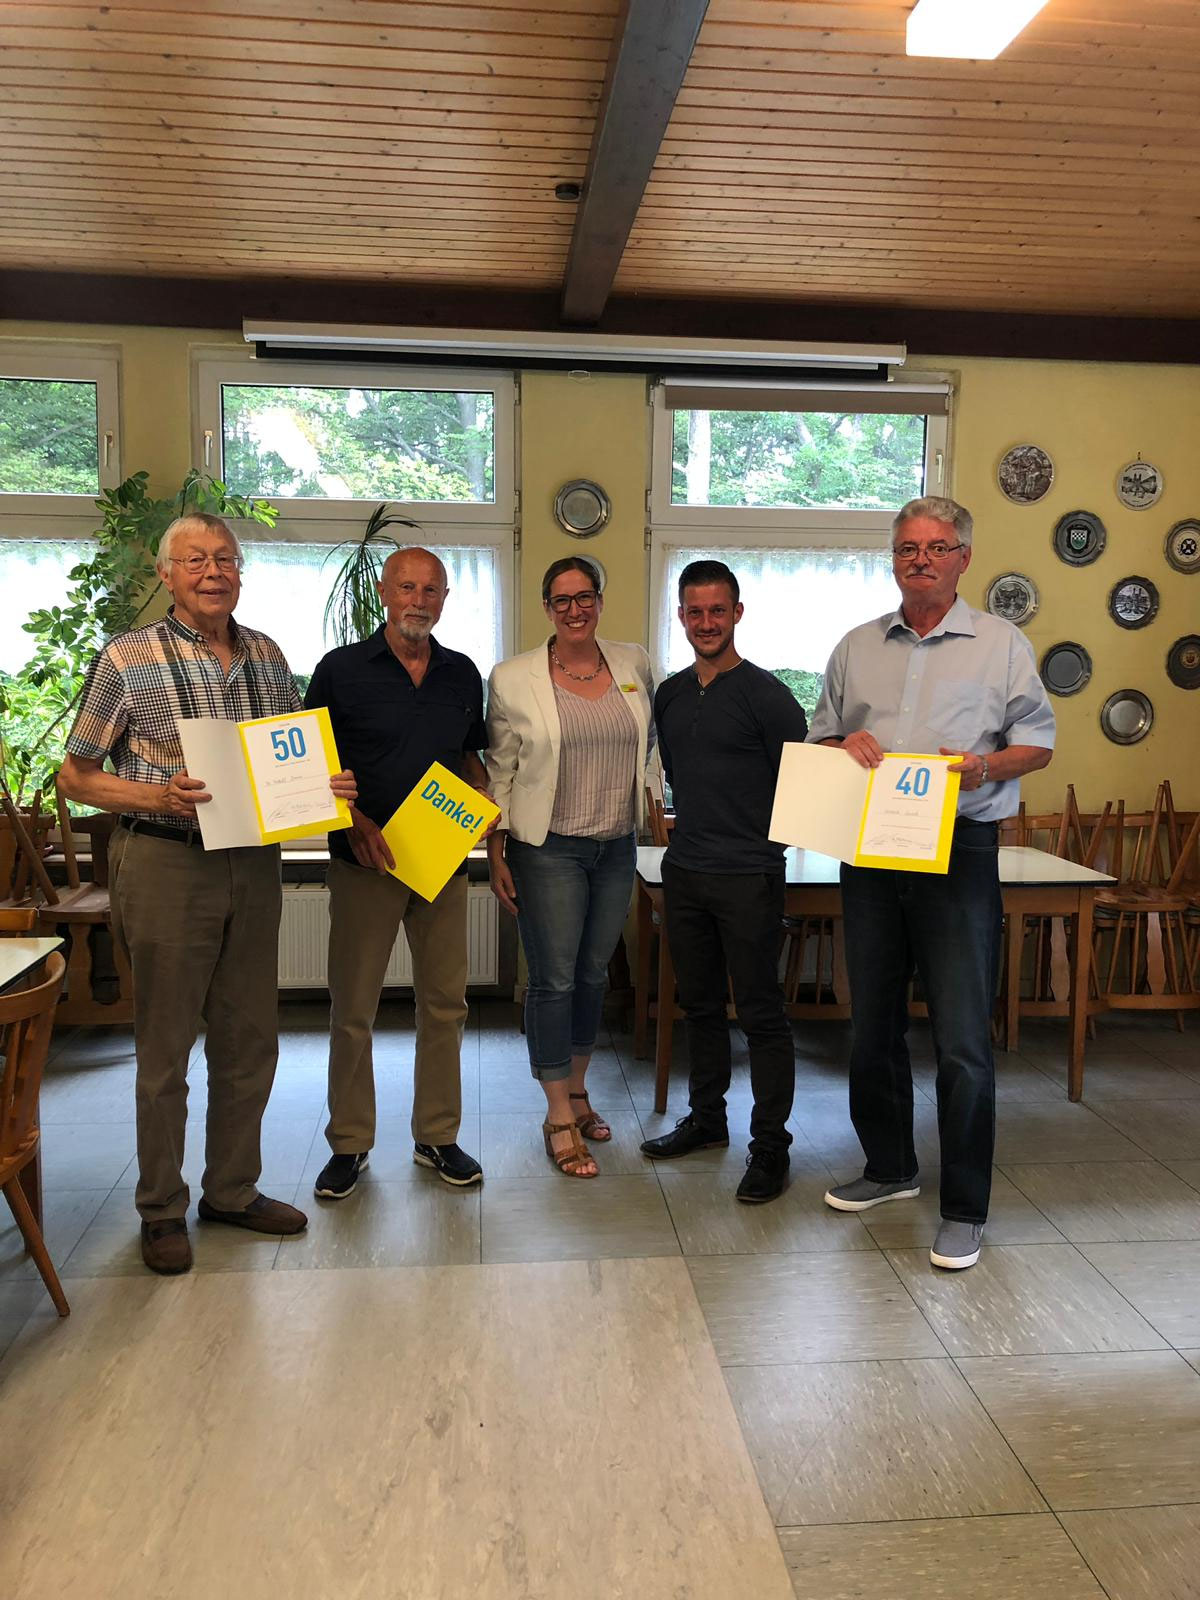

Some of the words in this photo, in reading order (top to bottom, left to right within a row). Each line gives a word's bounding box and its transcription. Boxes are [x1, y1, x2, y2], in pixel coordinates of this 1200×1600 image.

[270, 727, 307, 762] 50
[896, 766, 931, 797] 40
[421, 779, 484, 834] Danke!
